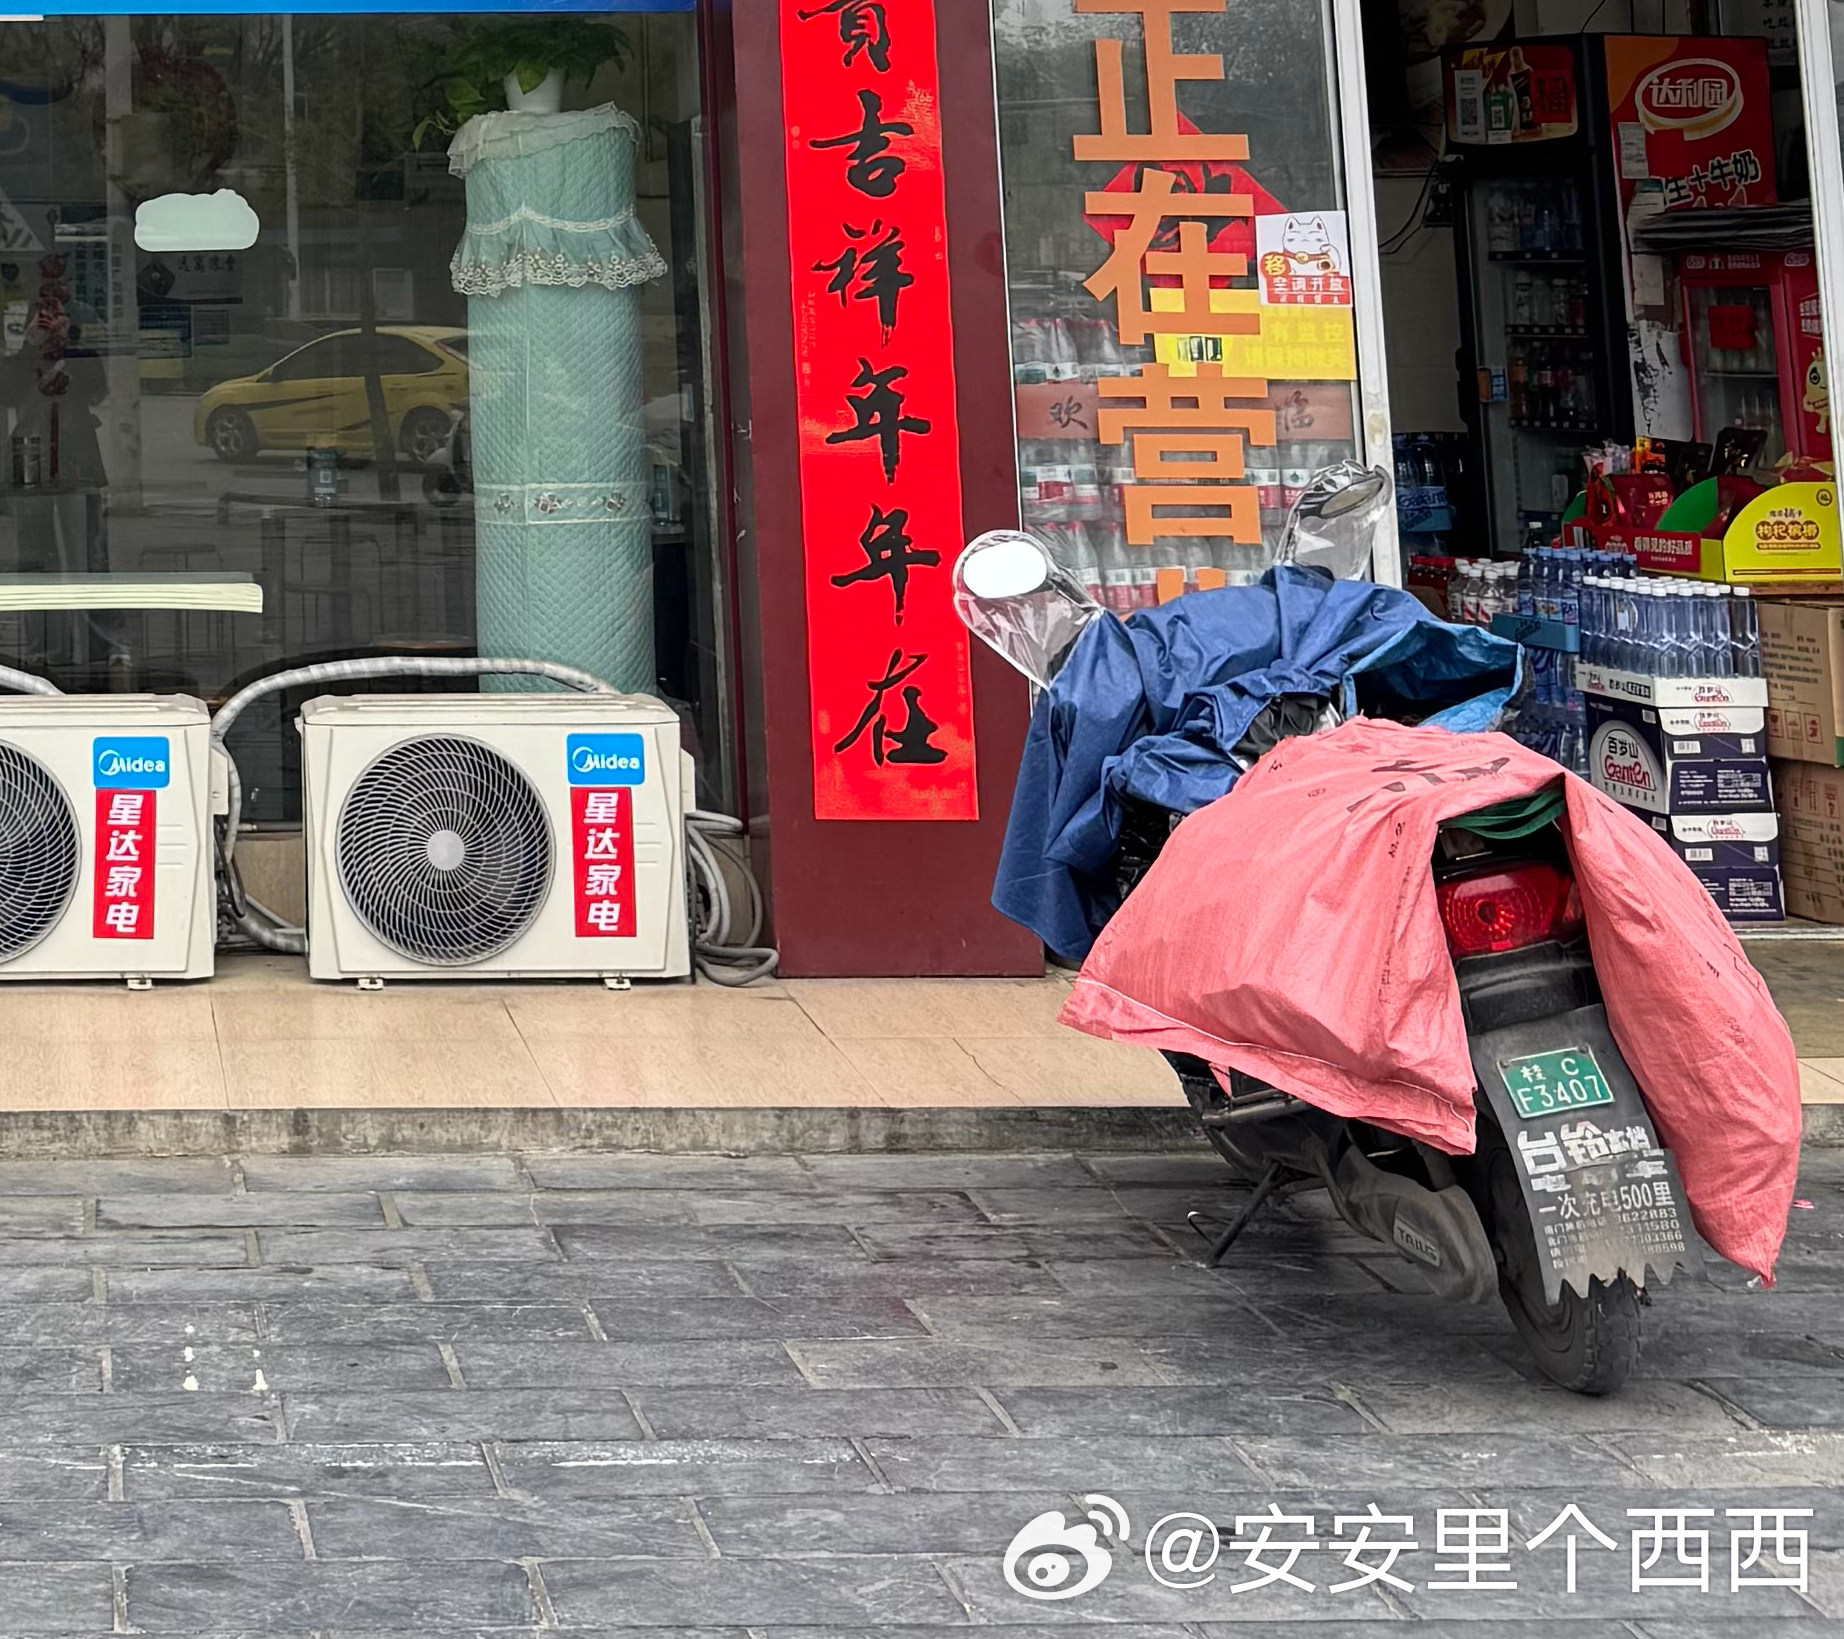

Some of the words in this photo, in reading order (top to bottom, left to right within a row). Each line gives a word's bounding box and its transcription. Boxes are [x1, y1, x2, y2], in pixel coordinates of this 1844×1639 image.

[103, 752, 165, 774] Midea
[577, 749, 640, 771] Midea
[1607, 736, 1639, 760] 百岁山
[104, 793, 144, 933] 星达家电
[582, 791, 622, 932] 星达家电
[1520, 1064, 1547, 1084] 桂
[1560, 1057, 1580, 1077] C
[1516, 1074, 1603, 1113] F3407
[1538, 1180, 1676, 1220] 一次充电500里
